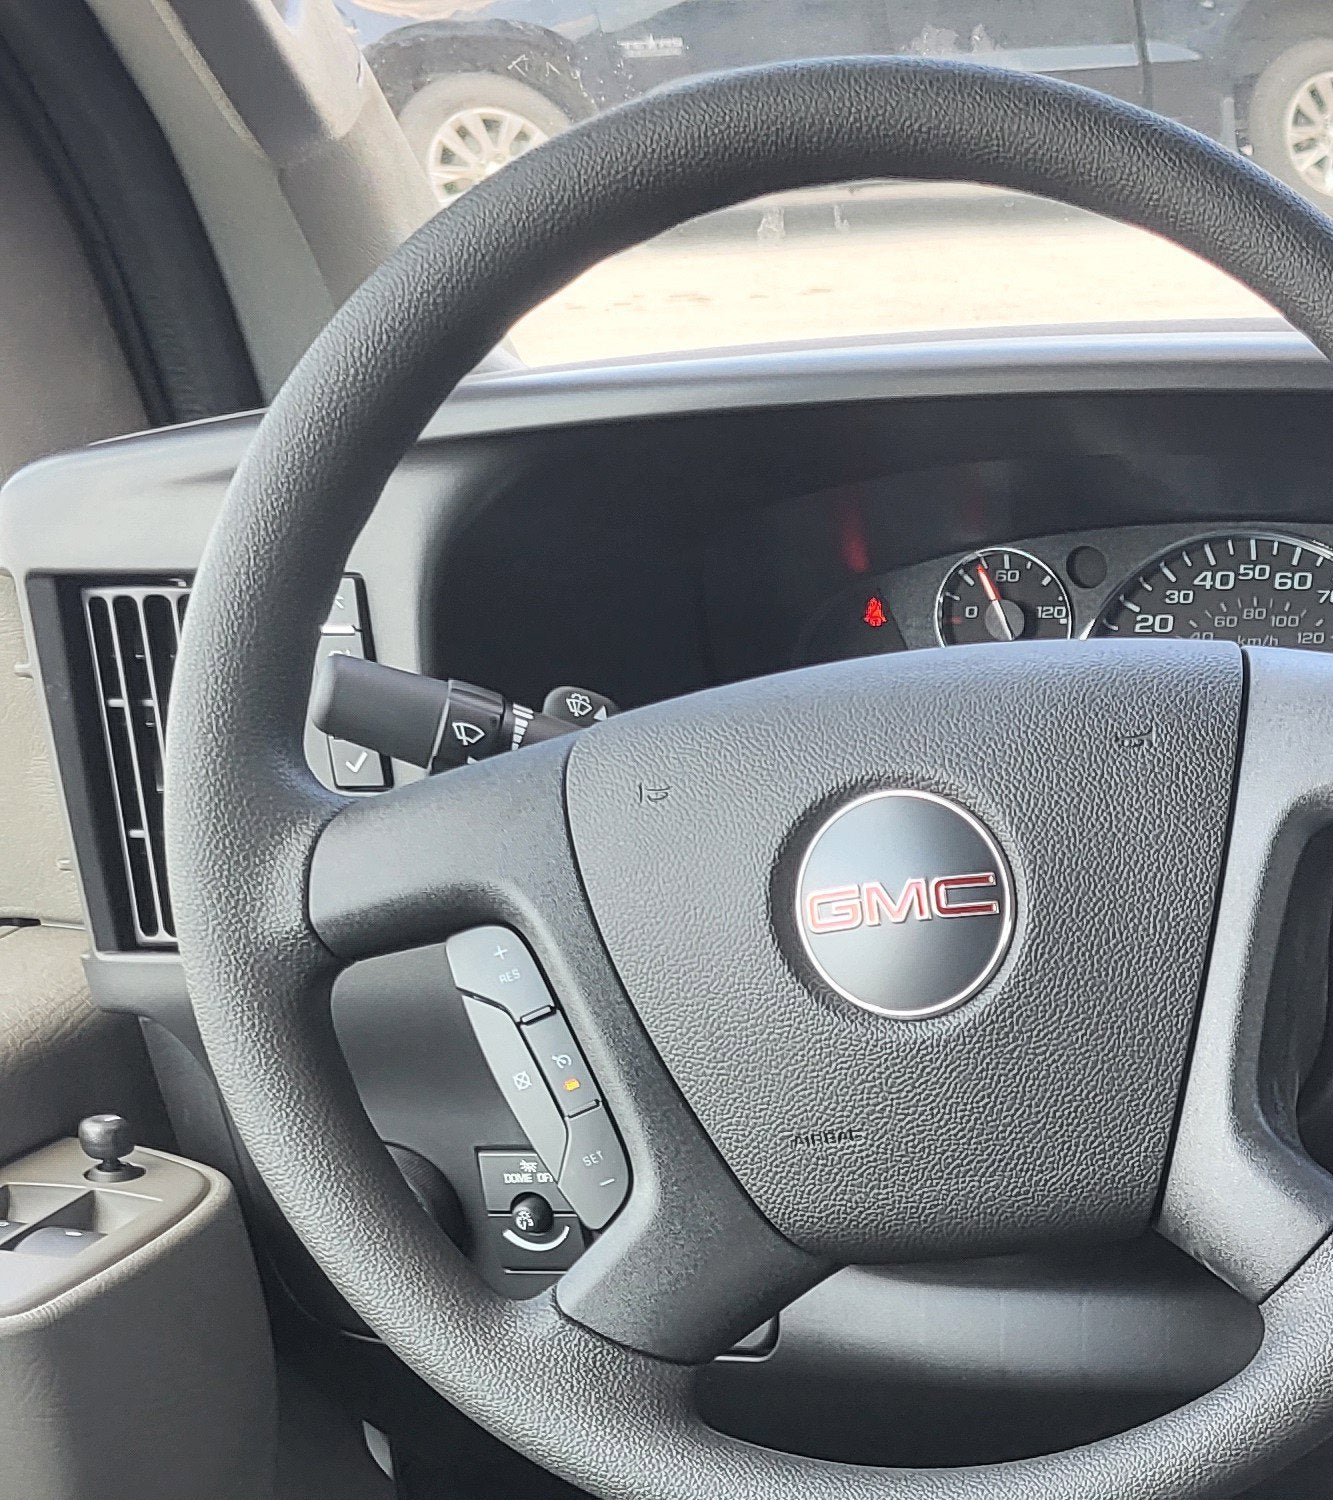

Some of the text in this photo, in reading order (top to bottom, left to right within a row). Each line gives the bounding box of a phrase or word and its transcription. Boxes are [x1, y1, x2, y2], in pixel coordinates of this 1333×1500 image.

[995, 570, 1020, 582] 60
[1238, 564, 1271, 580] 50
[1193, 571, 1235, 590] 40
[1274, 571, 1312, 590] 60
[1165, 590, 1194, 604] 30
[965, 606, 978, 619] 0
[1037, 605, 1066, 619] 120
[1243, 608, 1267, 620] 80
[1134, 614, 1174, 633] 20
[1214, 616, 1238, 628] 60
[1271, 615, 1299, 628] 100
[1237, 634, 1279, 646] km/h
[1297, 632, 1325, 644] 120
[807, 871, 1000, 935] GMC
[498, 968, 520, 983] RES
[582, 1150, 604, 1167] SET
[503, 1173, 533, 1184] DOME
